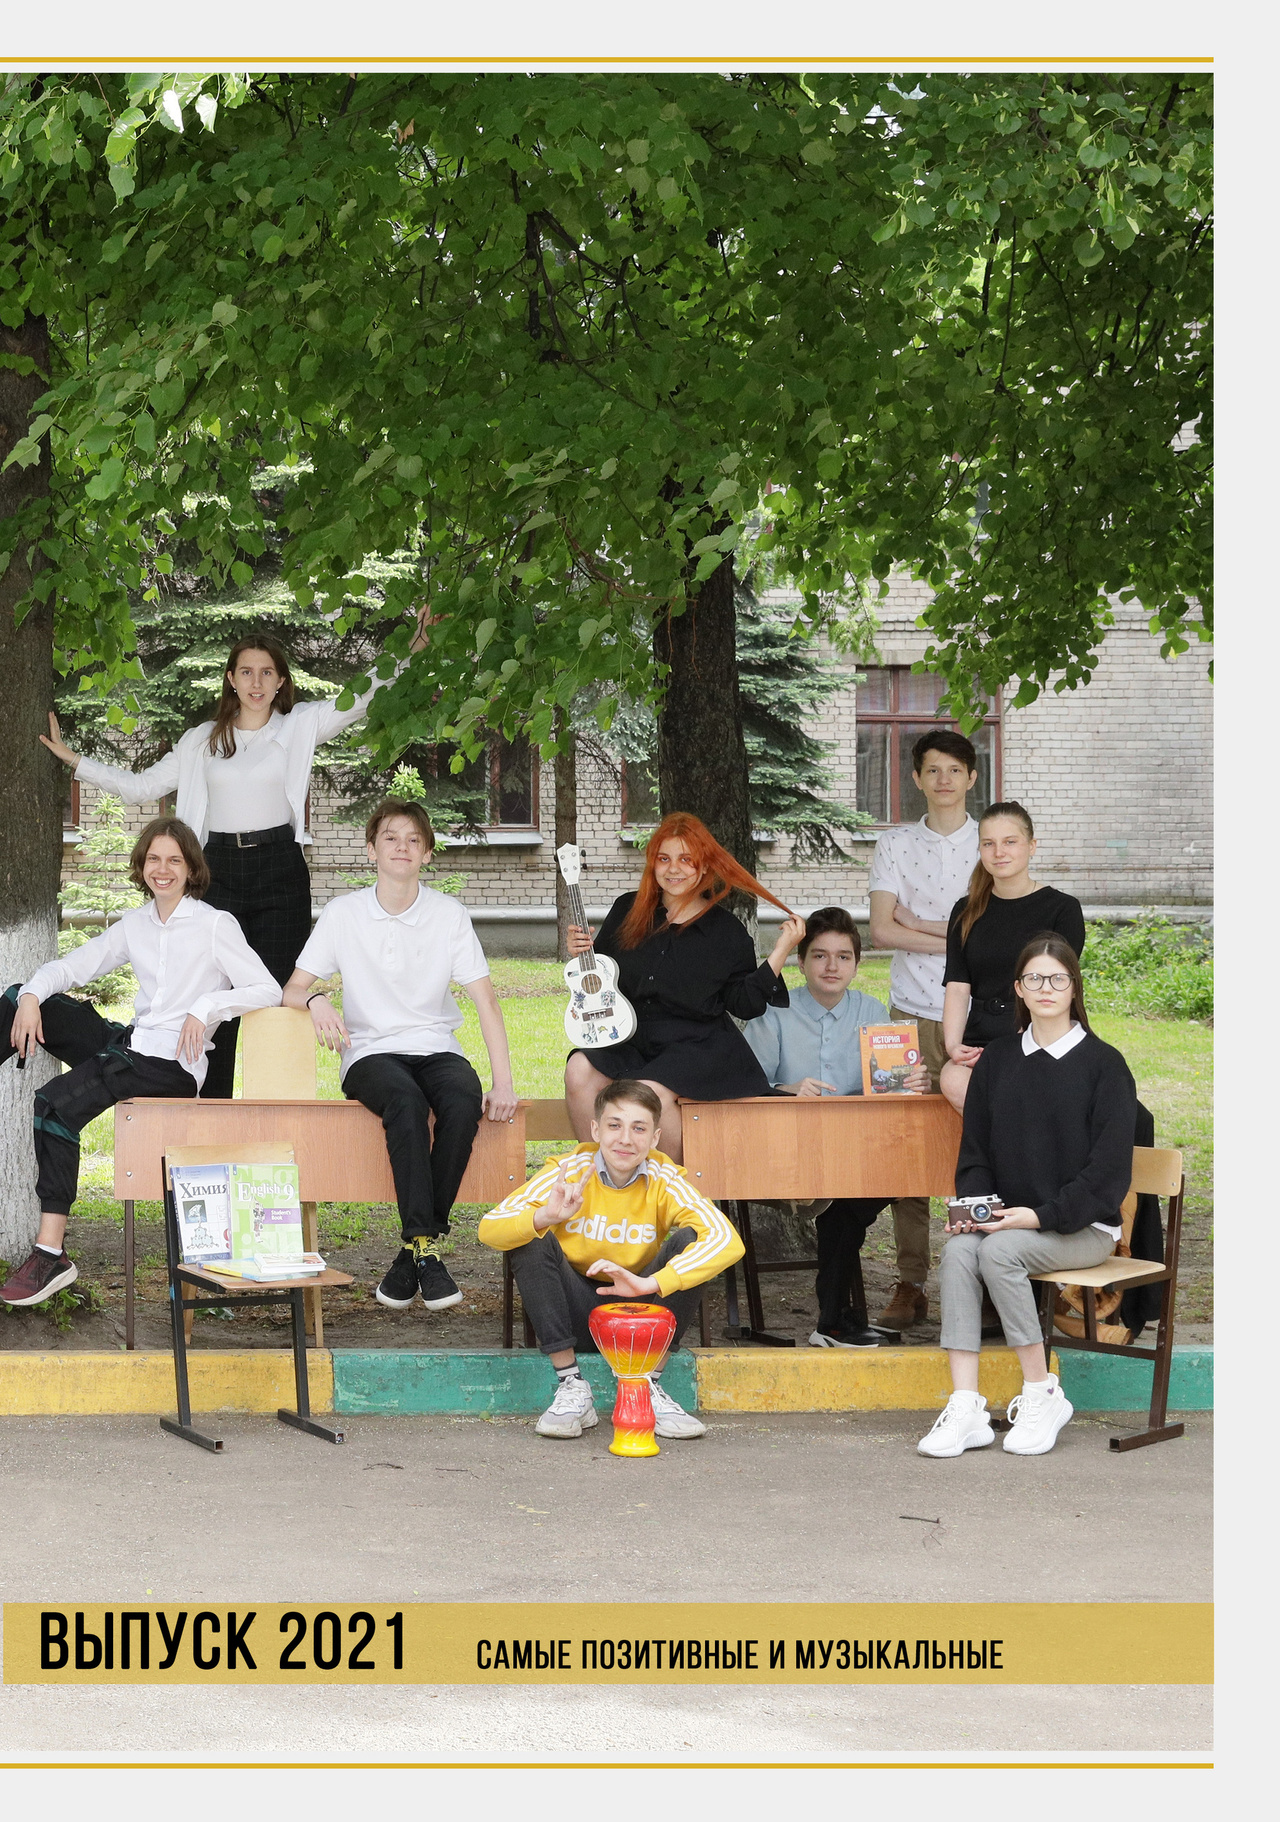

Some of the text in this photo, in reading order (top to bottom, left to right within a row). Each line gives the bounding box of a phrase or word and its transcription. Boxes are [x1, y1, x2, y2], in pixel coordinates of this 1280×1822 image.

[872, 1035, 901, 1044] ИСТОРИЯ
[907, 1050, 918, 1065] 9
[179, 1182, 227, 1199] Химия
[237, 1182, 295, 1202] English 9
[565, 1214, 657, 1244] adidas
